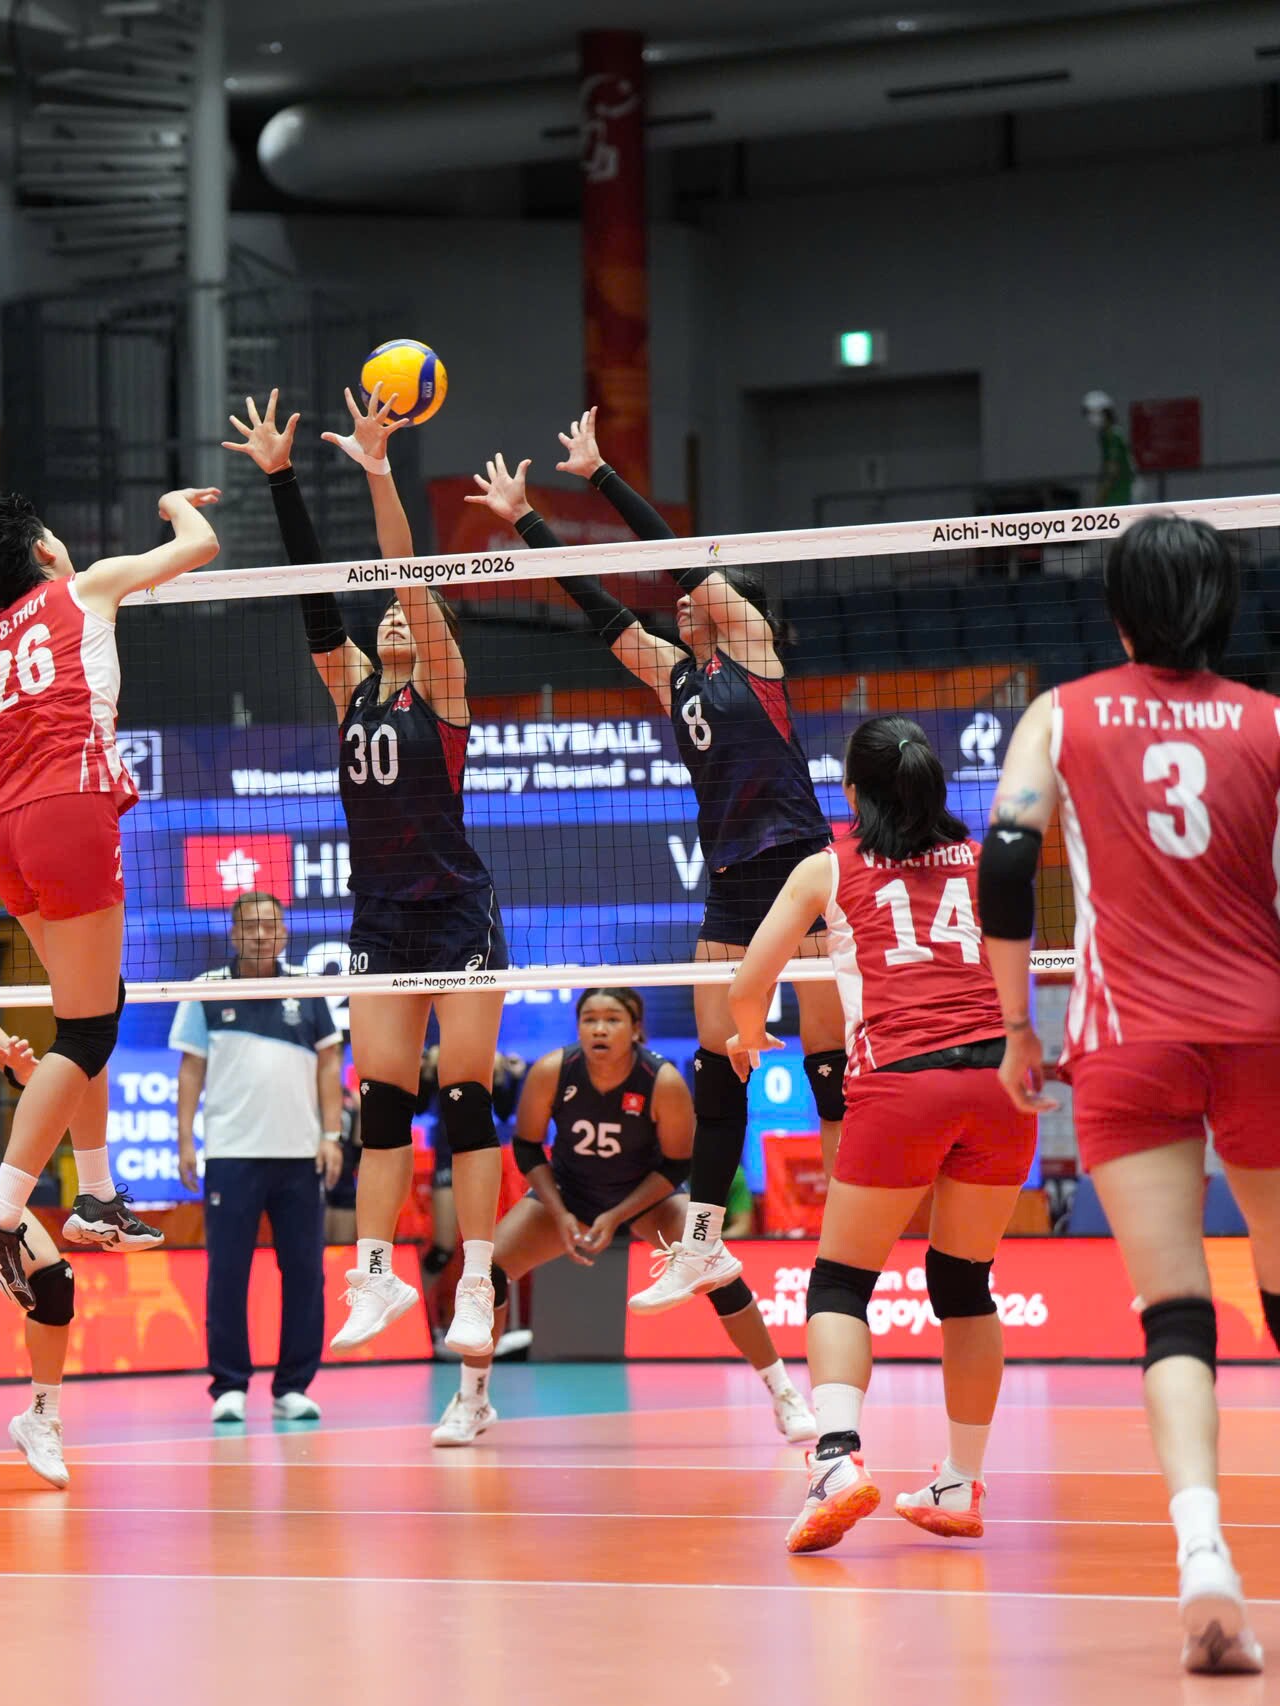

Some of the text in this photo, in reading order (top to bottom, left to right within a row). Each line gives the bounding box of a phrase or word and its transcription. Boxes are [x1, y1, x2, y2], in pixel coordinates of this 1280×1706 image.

[933, 513, 1120, 542] Aichi-Nagoya 2026
[347, 556, 515, 583] Aichi-Nagoya 2026
[681, 694, 712, 752] 8
[1094, 695, 1244, 731] T.T.T.THUY
[344, 723, 399, 786] 30
[466, 721, 662, 756] OLLEYBALL
[1142, 740, 1213, 860] 3
[874, 877, 982, 966] 14
[350, 952, 369, 975] 30
[1030, 956, 1075, 968] Nagoya
[392, 975, 497, 989] Aichi-Nagoya 2026
[764, 1065, 793, 1105] 0
[571, 1119, 622, 1158] 25
[692, 1218, 710, 1242] HKG
[370, 1254, 382, 1275] HKG
[774, 1267, 812, 1291] 20
[999, 1293, 1049, 1326] 26
